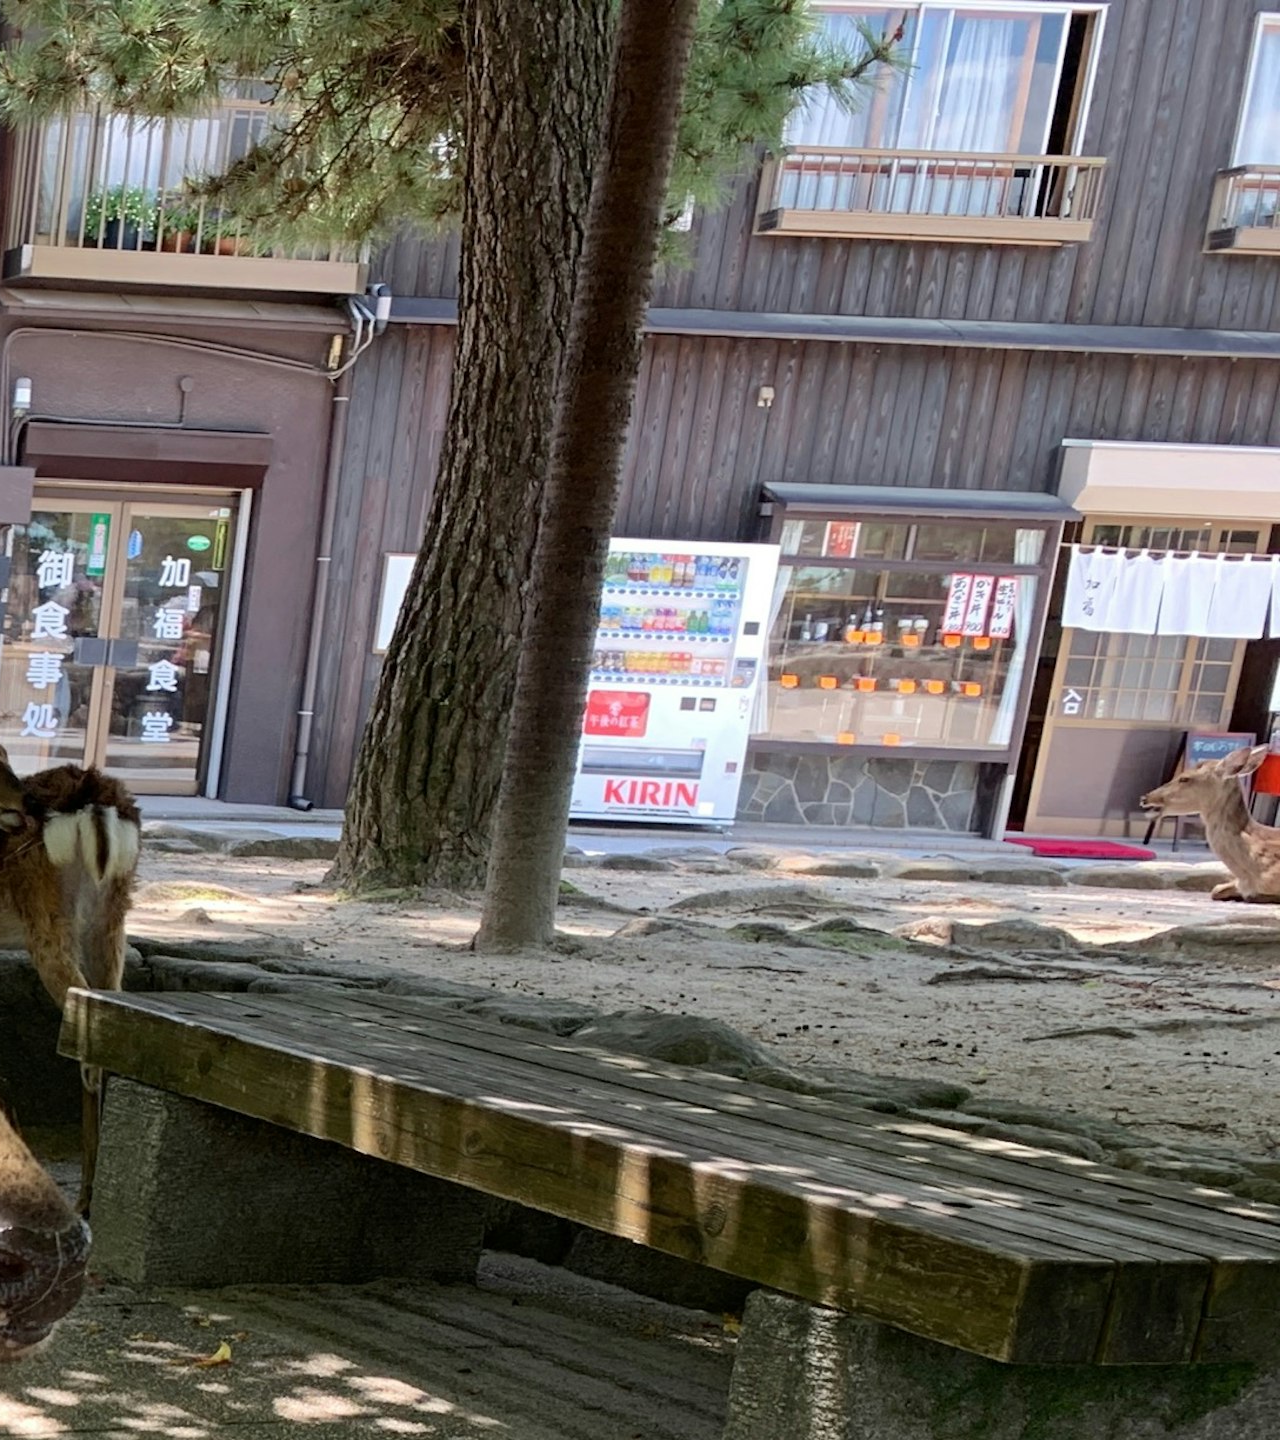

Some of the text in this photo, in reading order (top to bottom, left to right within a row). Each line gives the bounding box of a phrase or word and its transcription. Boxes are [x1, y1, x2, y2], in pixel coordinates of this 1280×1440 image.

[971, 580, 990, 617] かき丼
[19, 550, 75, 738] 御食事処
[140, 555, 191, 743] 加福食堂
[1062, 688, 1083, 714] 入口
[603, 778, 699, 807] KIRIN
